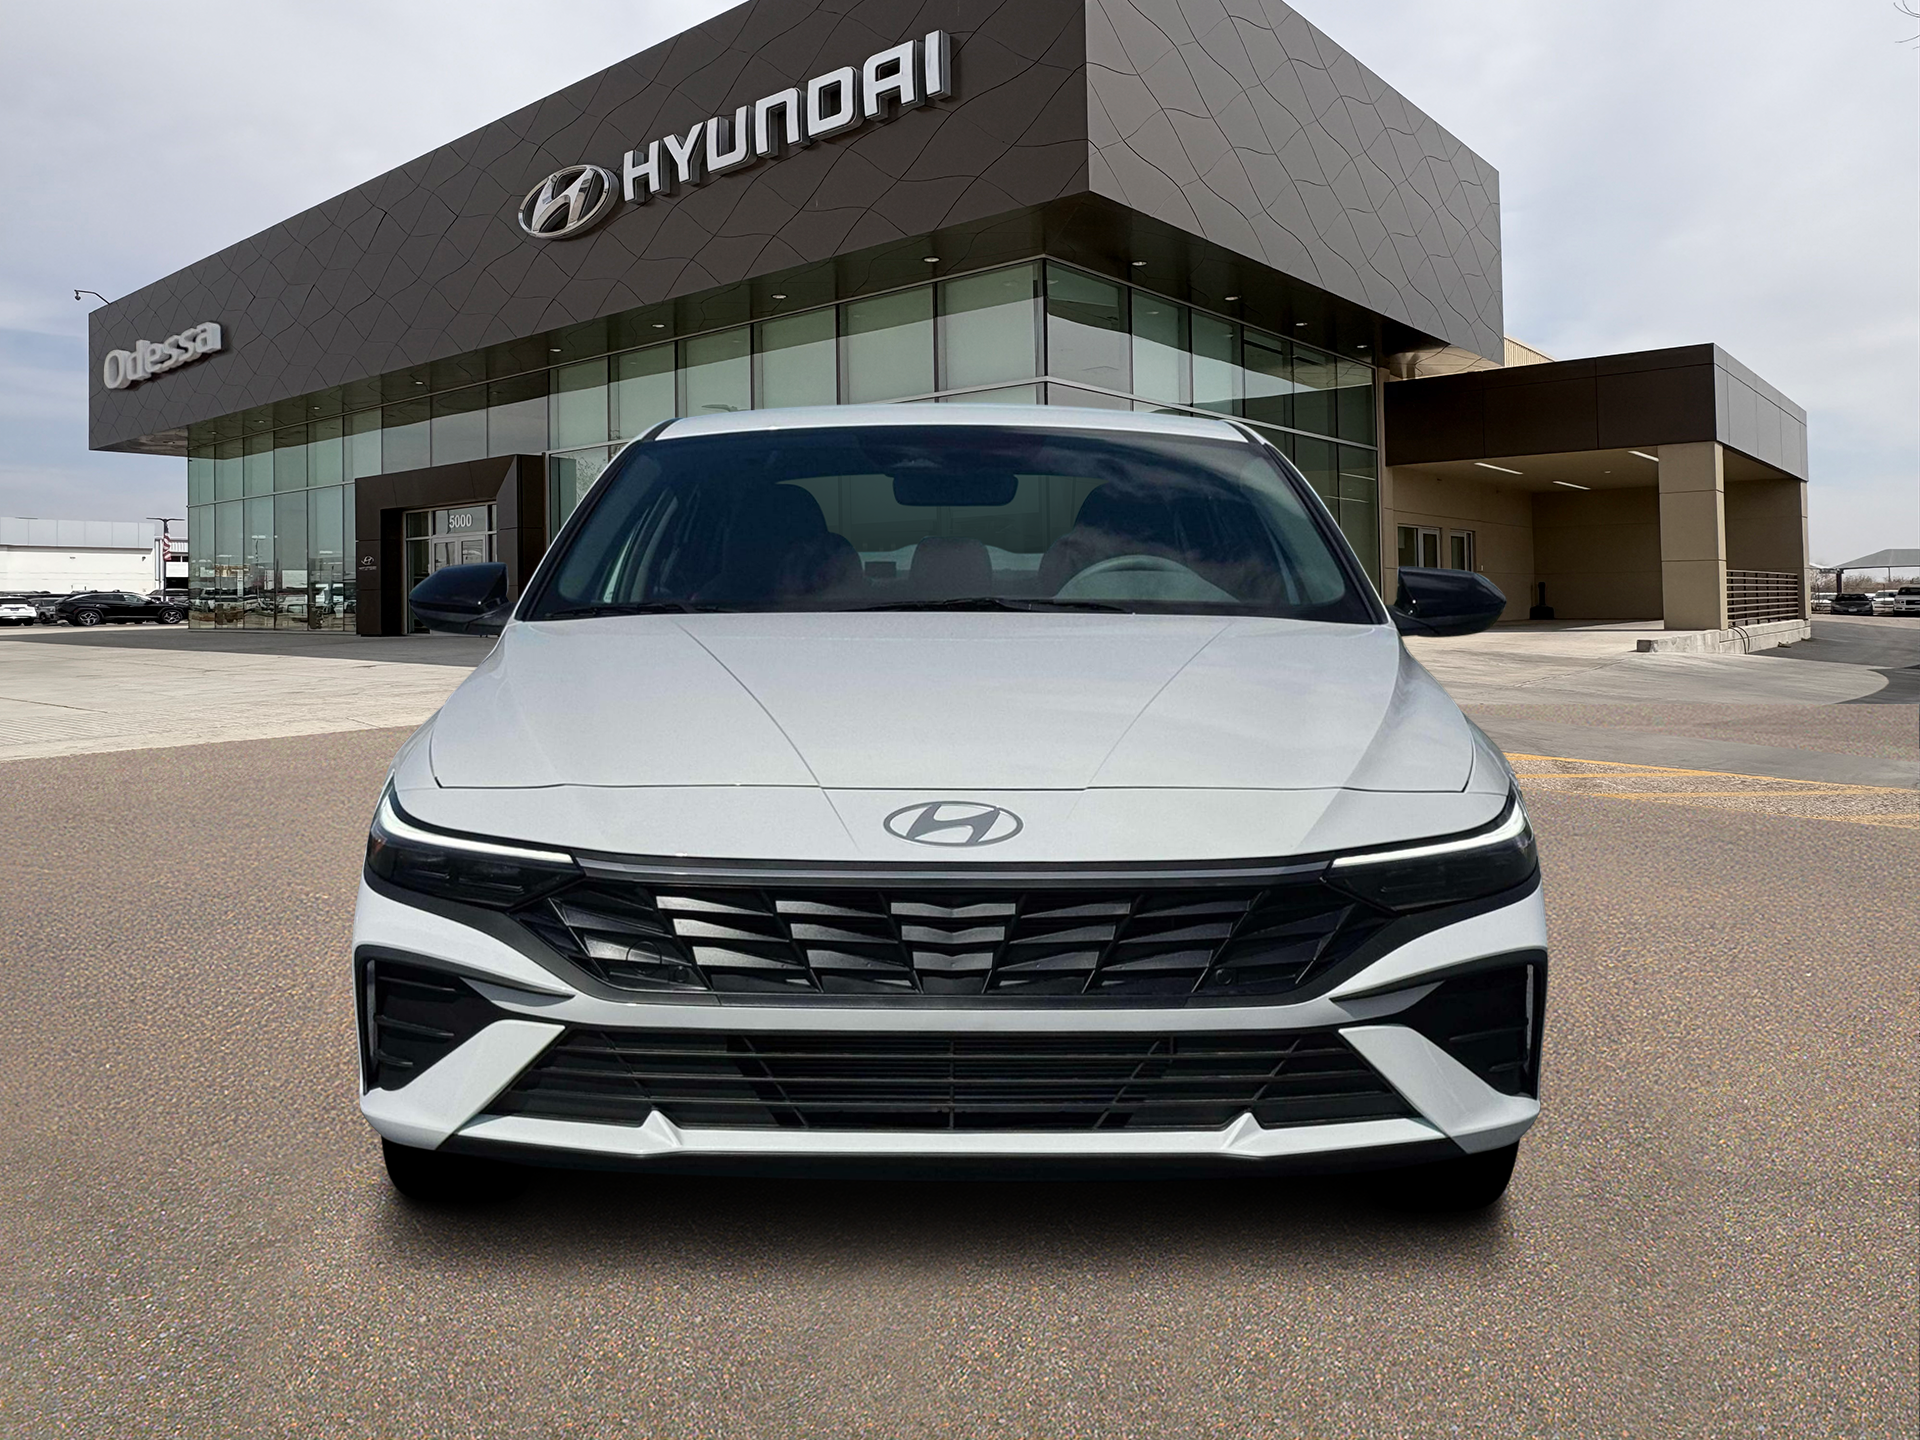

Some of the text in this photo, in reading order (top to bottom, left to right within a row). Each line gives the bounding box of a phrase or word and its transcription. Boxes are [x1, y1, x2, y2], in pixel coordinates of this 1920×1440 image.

[623, 30, 951, 203] HYUNDAI
[103, 322, 222, 389] Odessa
[448, 513, 472, 528] 5000
